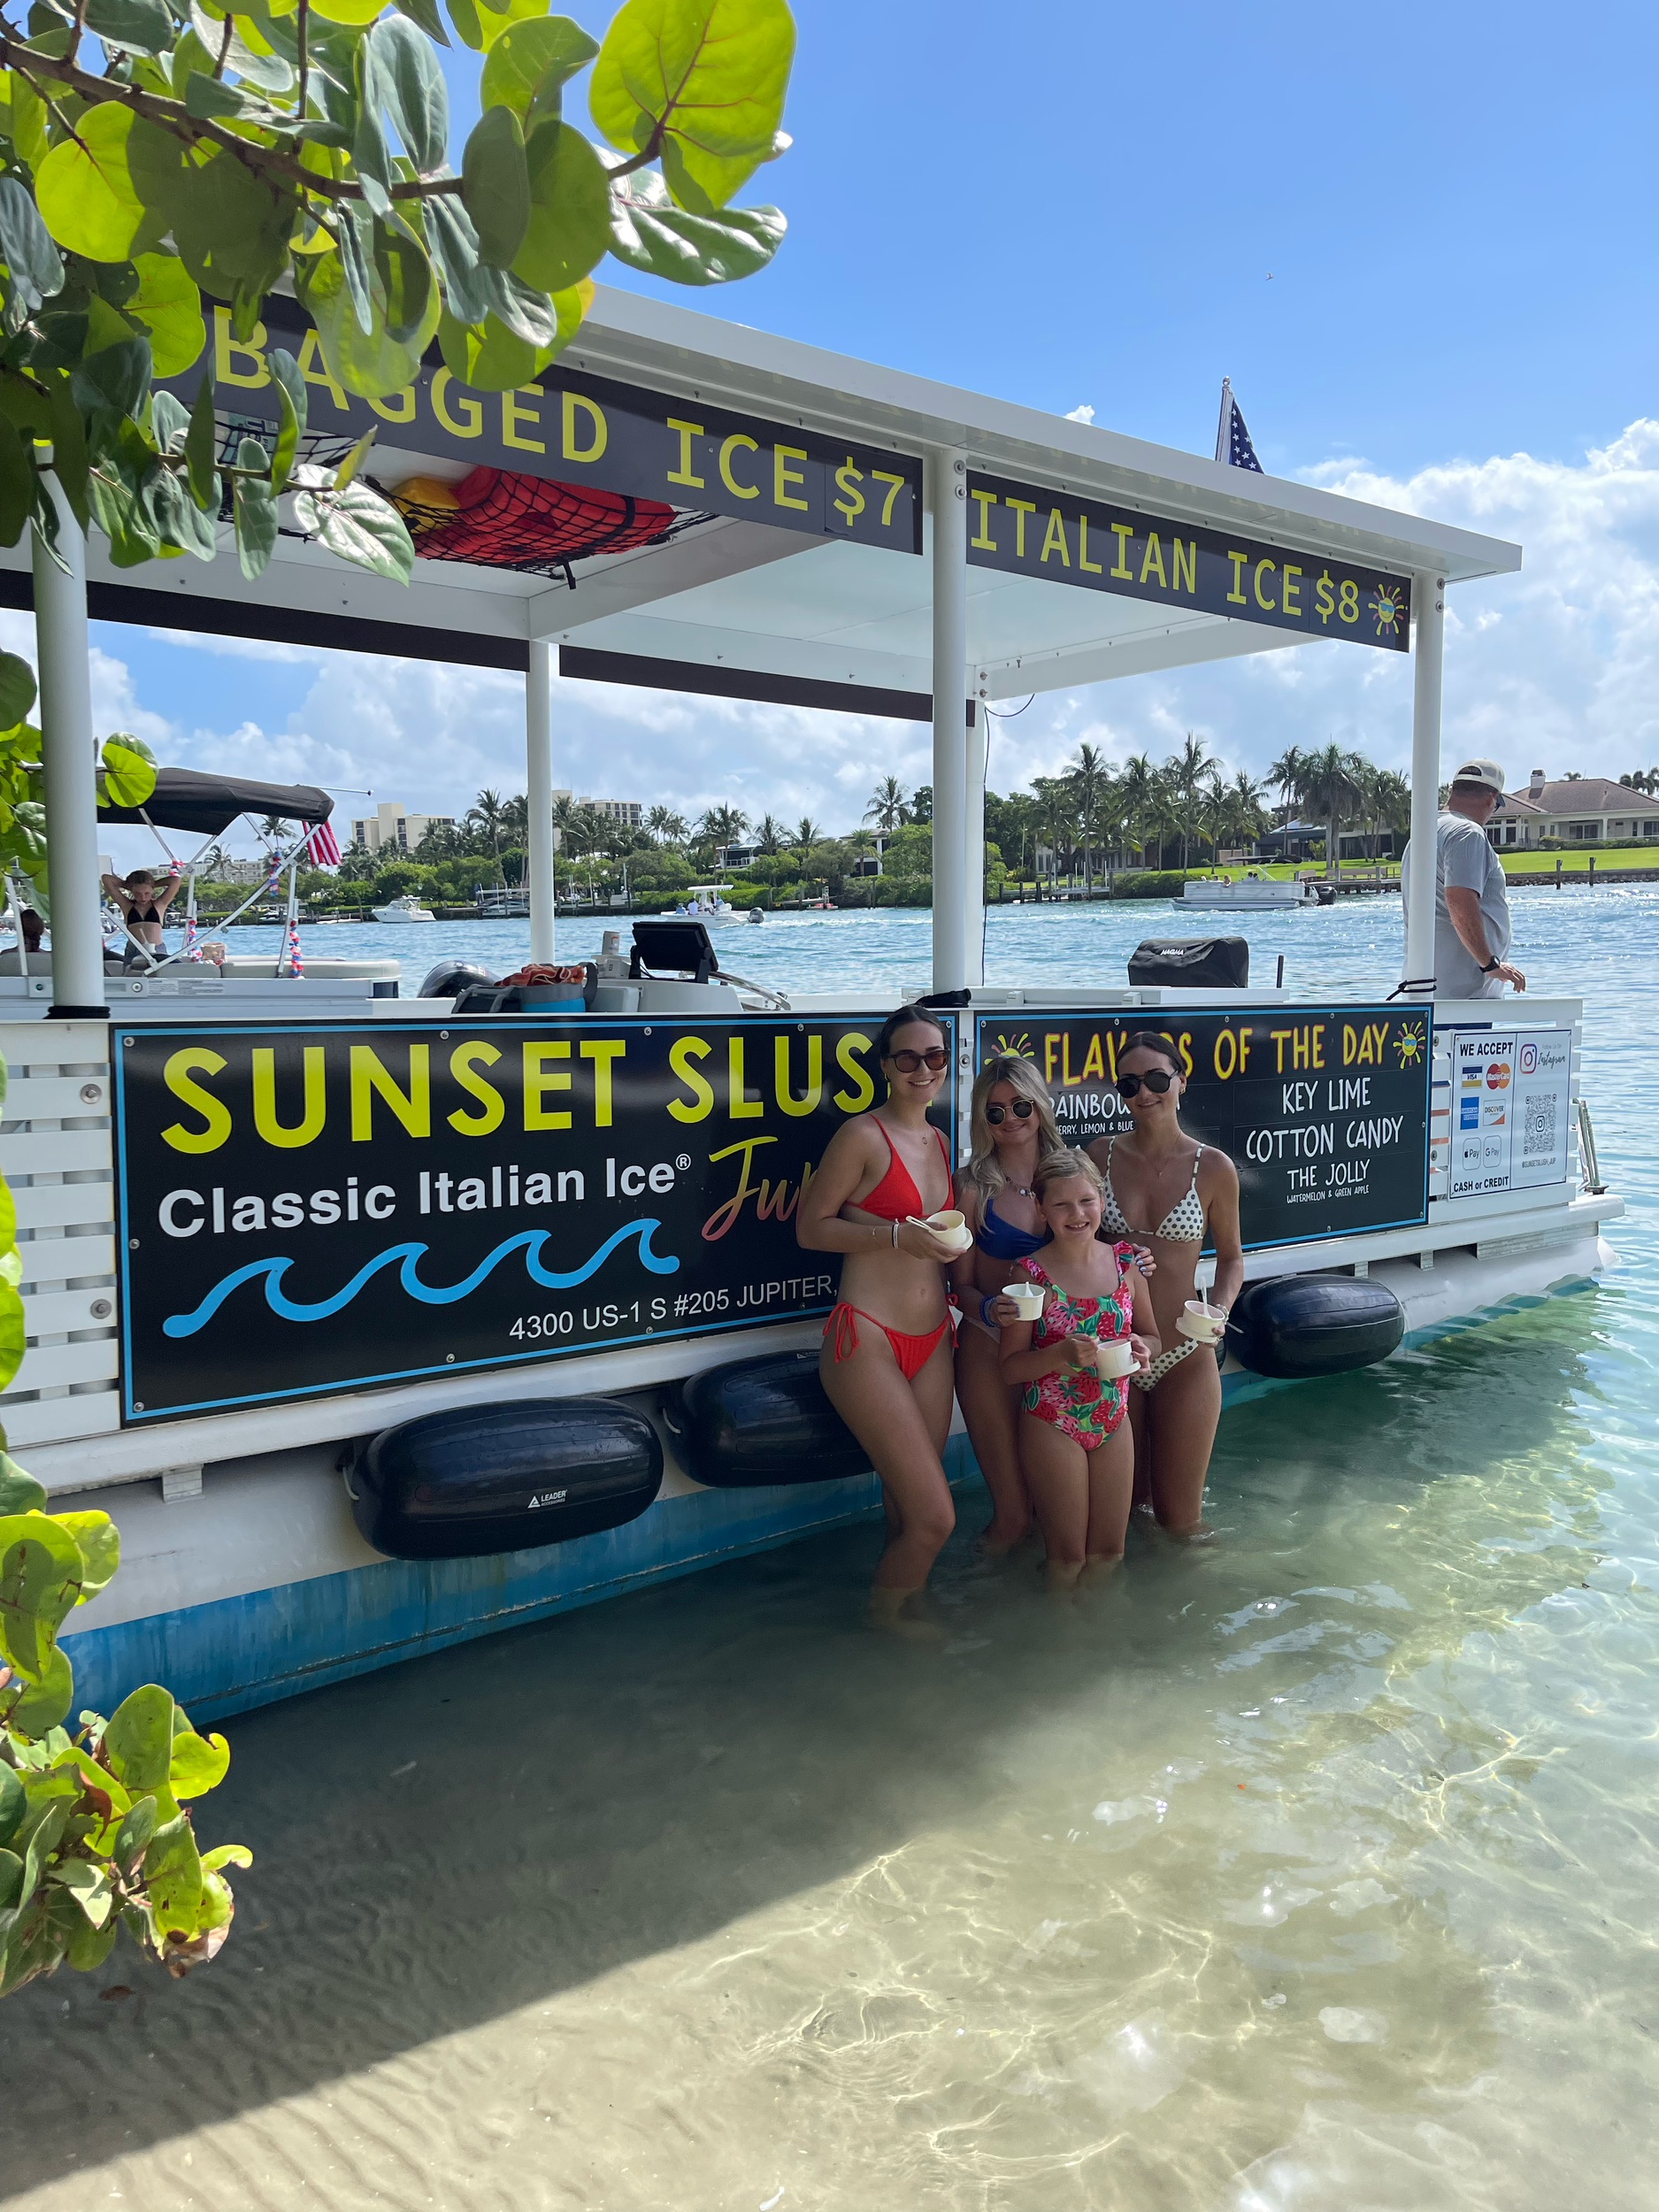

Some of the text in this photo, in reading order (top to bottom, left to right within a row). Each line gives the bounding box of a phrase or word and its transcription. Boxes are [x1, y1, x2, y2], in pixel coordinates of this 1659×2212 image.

[666, 418, 810, 512] ICE
[833, 456, 906, 527] $7
[971, 489, 1361, 625] ITALIAN ICE $8
[1044, 1021, 1389, 1087] FLAVS OF THE DAY
[1460, 1042, 1513, 1056] WE ACCEPT
[1538, 1051, 1565, 1069] Instagram
[160, 1032, 932, 1154] SUNSET SLUS
[1283, 1077, 1371, 1114] KEY LIME
[1057, 1120, 1133, 1135] ERRY, LEMON & BLUE
[1247, 1115, 1403, 1163] COTTON CANDY
[1470, 1148, 1479, 1159] Pay
[1286, 1158, 1371, 1190] THE JOLLY
[1454, 1180, 1473, 1192] CASH
[1484, 1176, 1509, 1188] CREDIT
[158, 1177, 396, 1237] Classic
[419, 1164, 585, 1214] Italian
[1286, 1184, 1370, 1203] WATERMELON & GREEN APPLE
[509, 1275, 838, 1340] 4300 US-1 S #205 JUPITER,
[541, 1490, 566, 1502] LEADER
